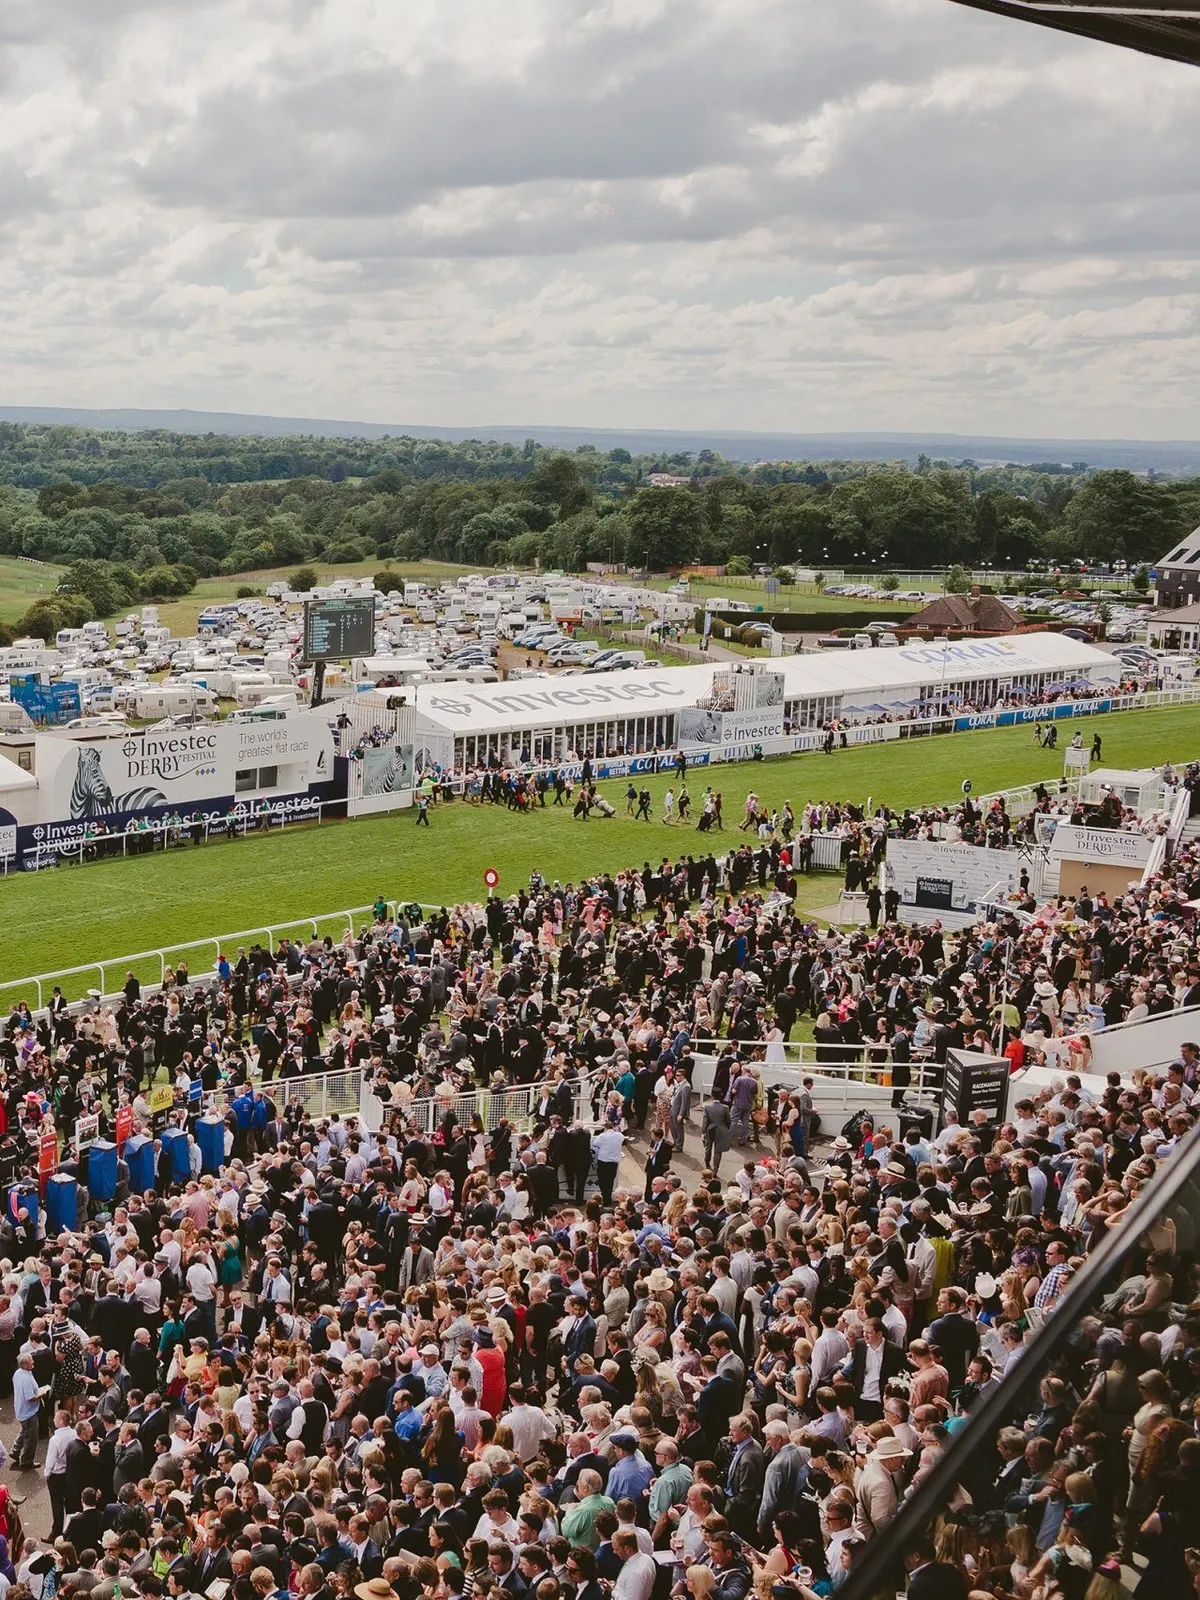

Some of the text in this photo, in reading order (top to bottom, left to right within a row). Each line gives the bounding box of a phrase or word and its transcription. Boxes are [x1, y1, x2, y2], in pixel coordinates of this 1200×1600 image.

[900, 641, 1016, 664] CORAL
[464, 680, 687, 714] Investec
[1022, 706, 1050, 720] CORAL
[1073, 699, 1100, 713] CORAL
[968, 713, 997, 728] CORAL
[240, 728, 288, 745] The world's
[734, 723, 782, 741] Investec
[141, 732, 217, 757] Investec
[239, 740, 309, 762] greatest flat race
[127, 749, 216, 780] DERBY FESTIVAL
[636, 755, 676, 771] COAL
[1077, 841, 1113, 852] DERBY
[1087, 832, 1139, 846] Investec
[940, 846, 977, 856] Investec
[972, 1081, 1001, 1089] RACEMAKERS
